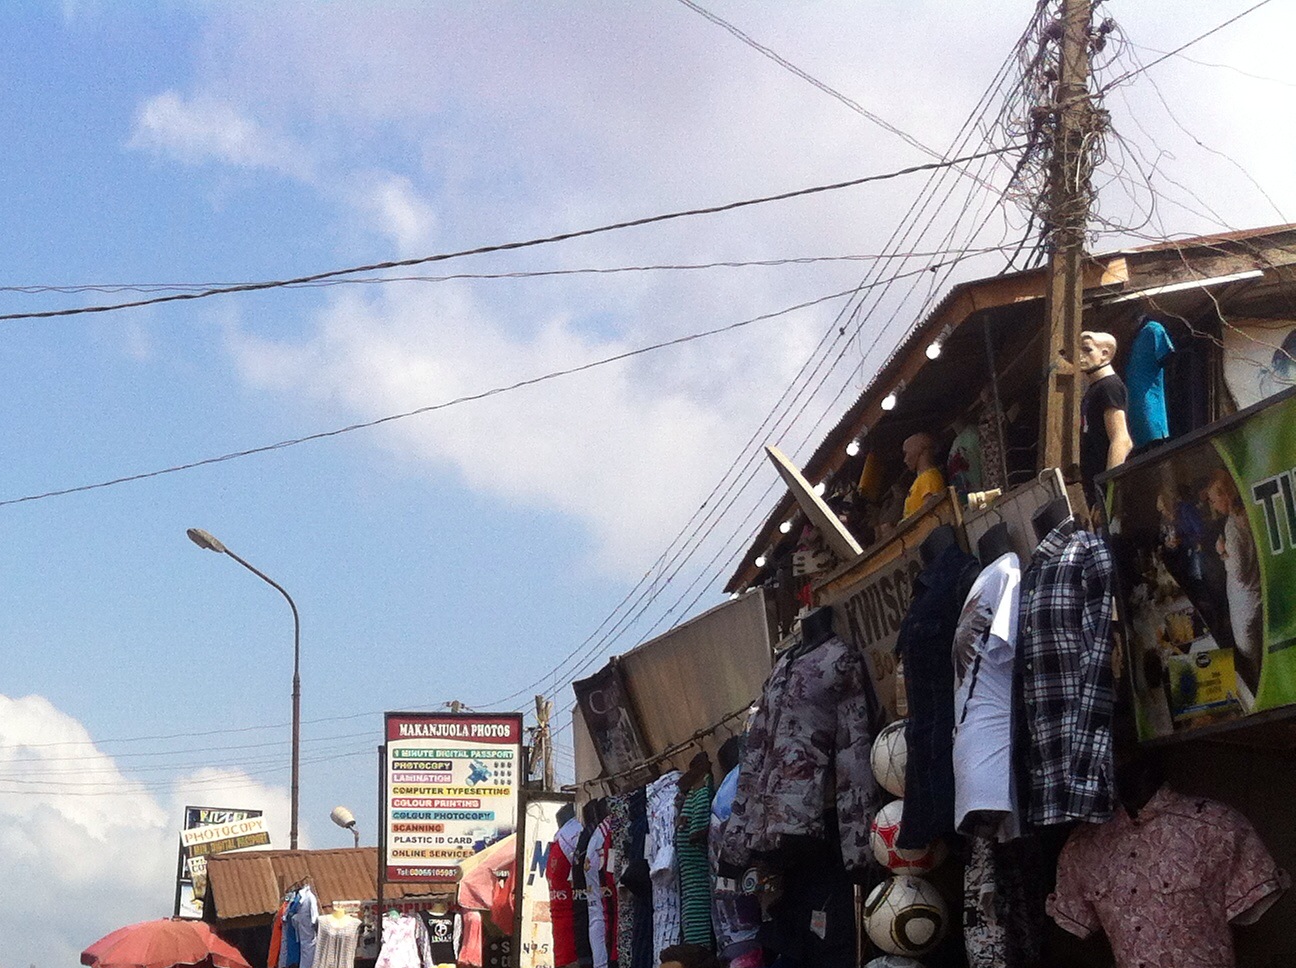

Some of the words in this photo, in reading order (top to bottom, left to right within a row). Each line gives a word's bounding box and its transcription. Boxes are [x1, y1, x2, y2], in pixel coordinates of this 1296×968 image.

[399, 723, 469, 737] MAKANJUOLA
[471, 724, 511, 738] PHOTOS
[401, 749, 435, 758] MINUTE
[436, 750, 469, 758] DIGITAL
[470, 750, 514, 759] PASSPORT
[394, 762, 451, 771] PHOTOCOPY
[394, 774, 452, 783] LAMINATION
[393, 787, 444, 796] COMPUTER
[447, 787, 510, 796] TYPESETTING
[393, 799, 432, 808] COLOUR
[434, 800, 479, 808] PRINTING
[393, 812, 432, 821] COLOUR
[434, 812, 491, 821] PHOTOCOPY
[184, 820, 263, 844] PHOTOCOPY
[393, 824, 442, 833] SCANNING
[394, 836, 433, 845] PLASTIC
[435, 837, 445, 845] ID
[447, 837, 473, 845] CARD
[392, 849, 426, 858] ONLINE
[429, 850, 474, 859] SERVICES
